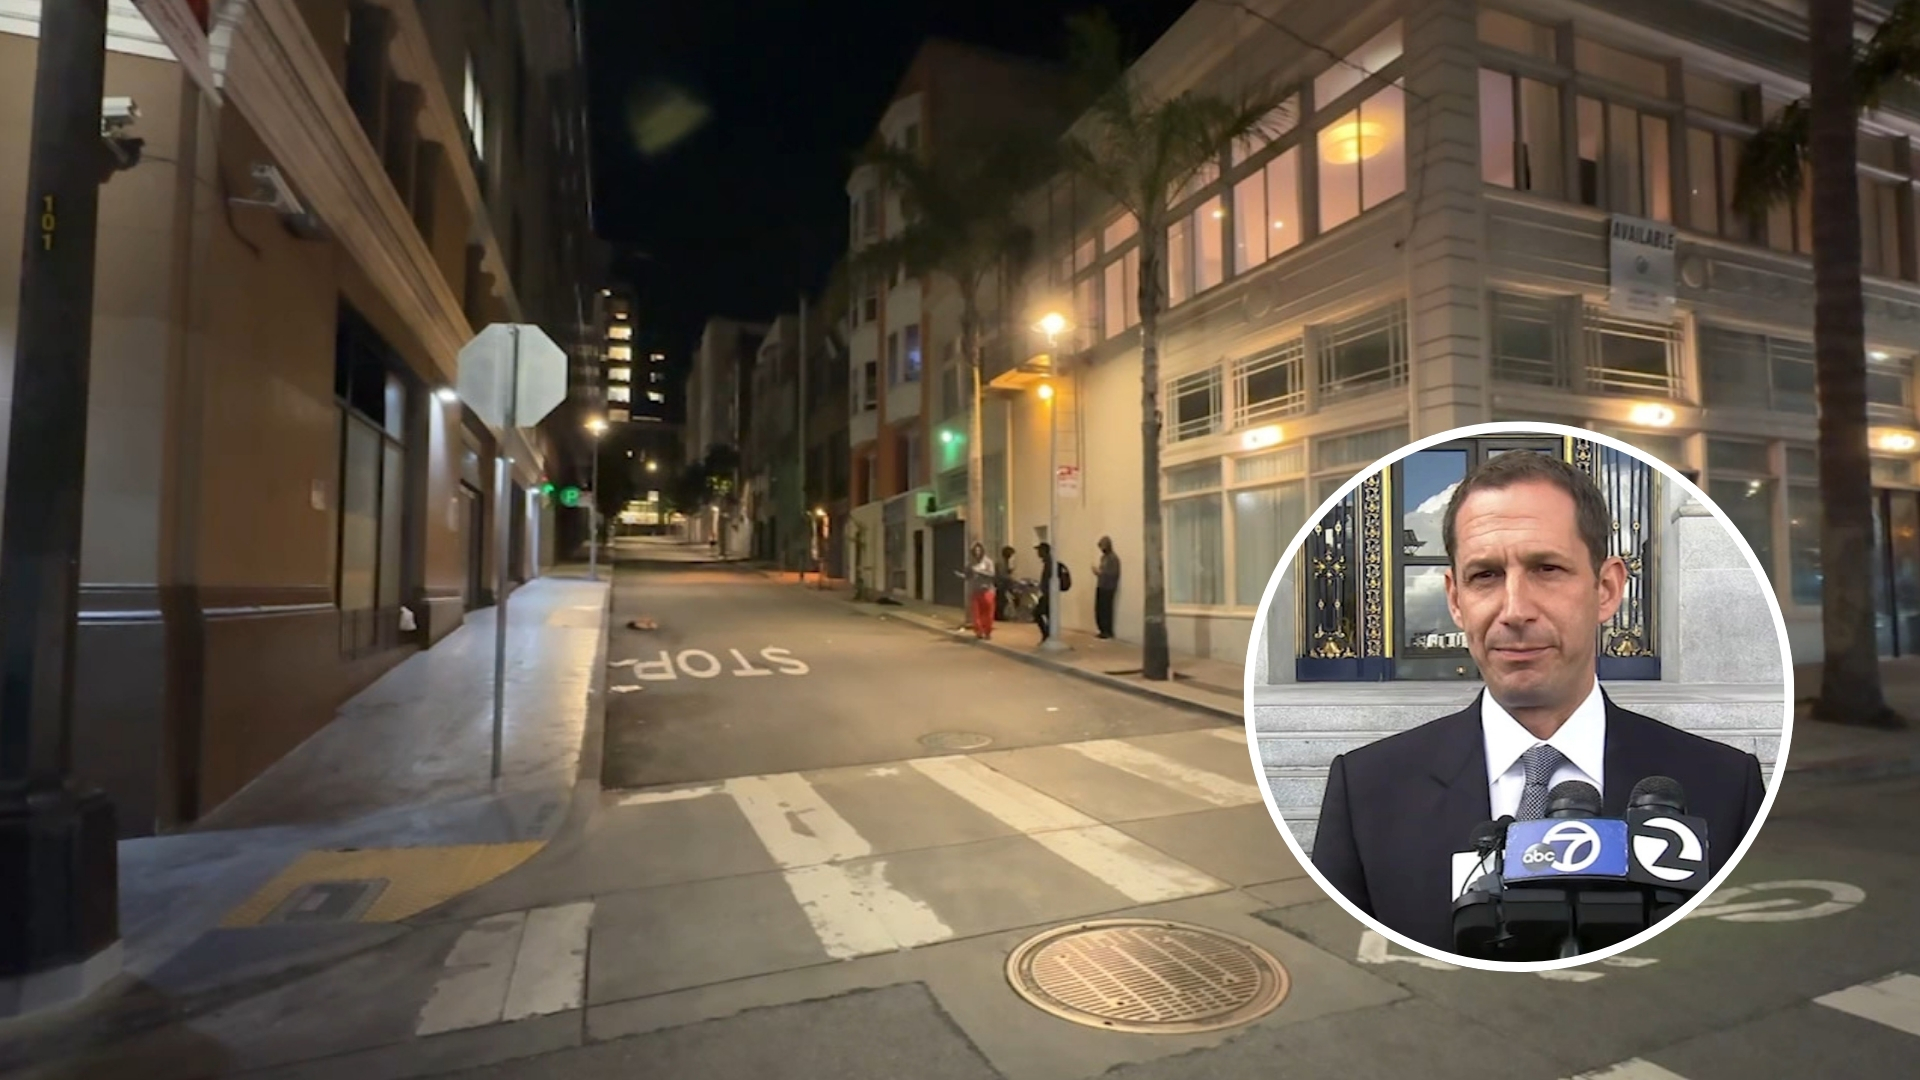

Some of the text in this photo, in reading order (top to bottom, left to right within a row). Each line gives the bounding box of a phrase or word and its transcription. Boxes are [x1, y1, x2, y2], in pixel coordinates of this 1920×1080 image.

[42, 195, 55, 250] 101
[1613, 222, 1674, 250] AVAILABLE
[567, 490, 579, 504] P
[633, 647, 810, 681] STOP
[1523, 820, 1601, 872] abc 7
[1633, 817, 1702, 881] 2
